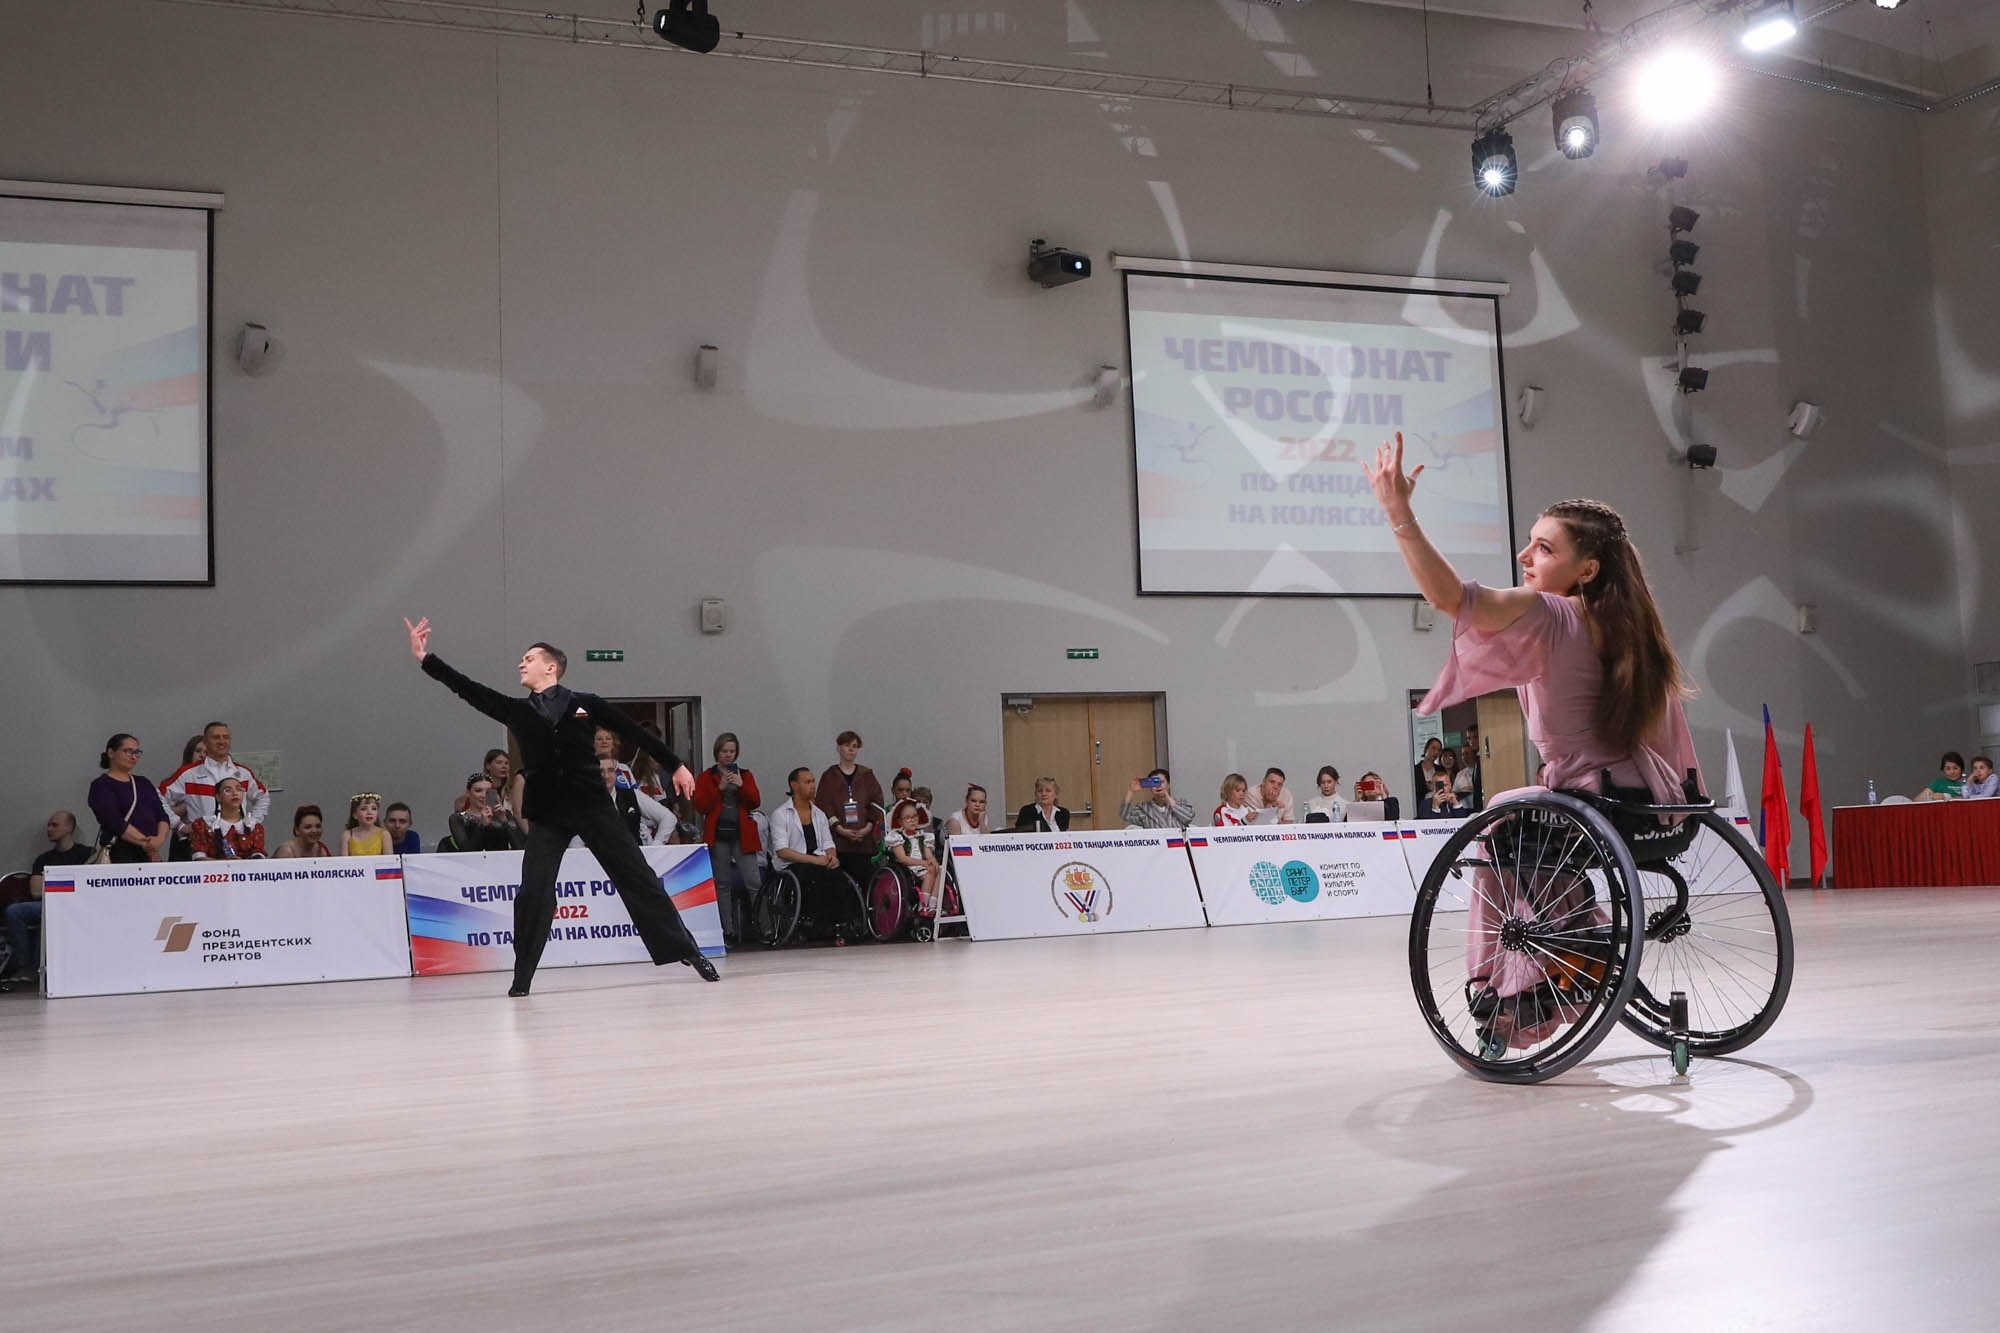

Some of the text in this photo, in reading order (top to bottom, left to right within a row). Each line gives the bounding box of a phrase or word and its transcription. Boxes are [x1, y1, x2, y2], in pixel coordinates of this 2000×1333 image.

[1164, 337, 1453, 382] ЧЕМПИОНАТ
[1223, 386, 1404, 425] РОССИИ
[1277, 437, 1357, 462] 2022
[1240, 472, 1374, 497] ПО ТАНЦА
[1229, 504, 1391, 527] НА КОЛЯСКА
[1213, 835, 1254, 844] ЧЕМПИОНАТ
[1255, 834, 1280, 842] РОССИИ
[1281, 833, 1297, 841] 2022
[1307, 832, 1334, 841] ТАНЦАМ
[1335, 831, 1344, 839] НА
[1344, 831, 1377, 839] КОЛЯСКАХ
[979, 838, 1160, 853] ЧЕМПИОНАТ РОССИИ 2022 ПО ТАНЦАМ НА КОЛЯСКАХ
[1320, 862, 1361, 871] КОМИТЕТ ПО
[86, 869, 365, 887] ЧЕМПИОНАТ РОССИИ 2022 ПО ТАНЦАМ НА КОЛЯСКАХ
[1322, 870, 1366, 879] ФИЗИЧЕСКОЙ
[1287, 877, 1311, 887] ПЕТЕР
[1324, 880, 1355, 888] КУЛЬТУРЕ
[1290, 886, 1309, 896] БУРГ
[1333, 889, 1359, 897] СПОРТУ
[551, 905, 589, 920] 2022
[201, 928, 241, 938] ФОНД
[467, 932, 491, 946] ПО
[566, 925, 588, 941] НА
[202, 937, 312, 951] ПРЕЗИДЕНТСКИХ
[203, 952, 262, 963] ГРАНТОВ
